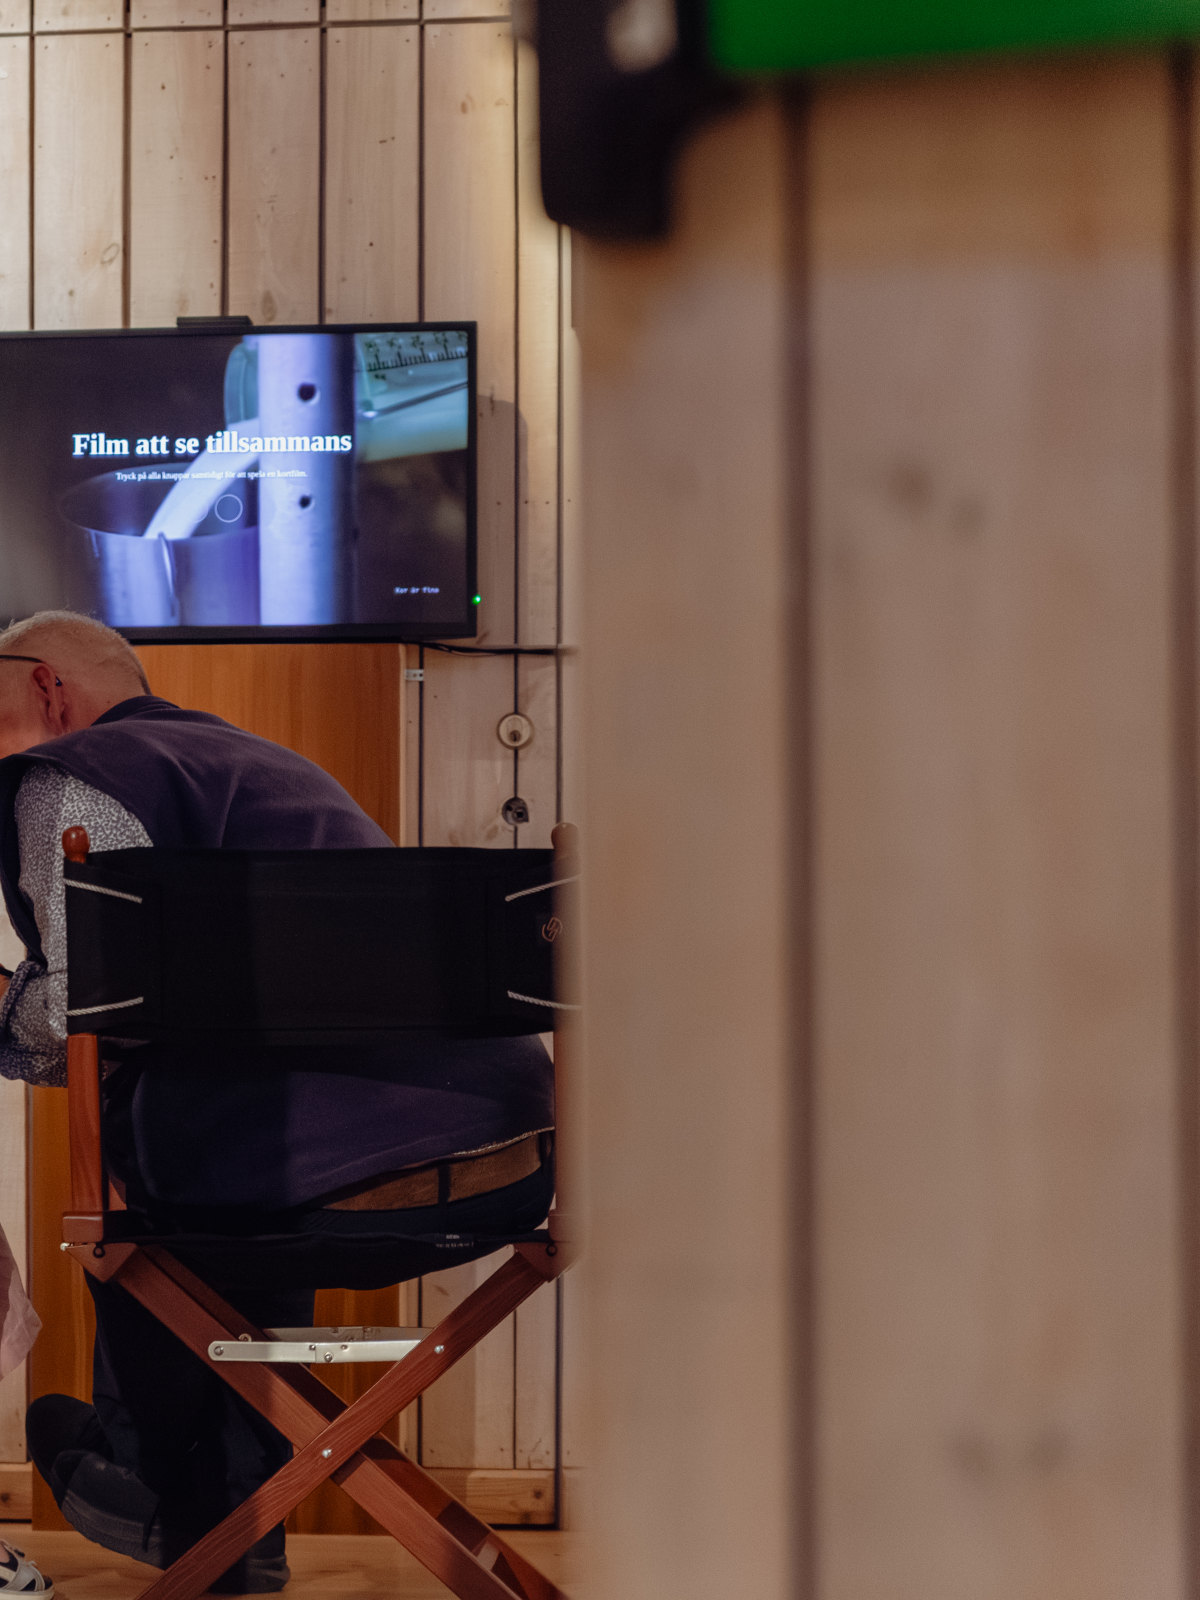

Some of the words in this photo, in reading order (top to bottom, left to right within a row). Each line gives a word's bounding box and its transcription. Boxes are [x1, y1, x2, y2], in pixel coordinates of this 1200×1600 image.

[72, 433, 130, 456] Film
[136, 436, 170, 454] att
[175, 437, 200, 454] se
[206, 431, 352, 453] tillsammans
[116, 472, 136, 481] Tryck
[138, 472, 147, 481] på
[148, 472, 161, 480] alla
[162, 472, 190, 481] knappar
[191, 471, 224, 480] samtidigt
[248, 471, 266, 480] spela
[394, 586, 408, 594] Kor
[410, 586, 420, 594] är
[422, 586, 440, 594] fina
